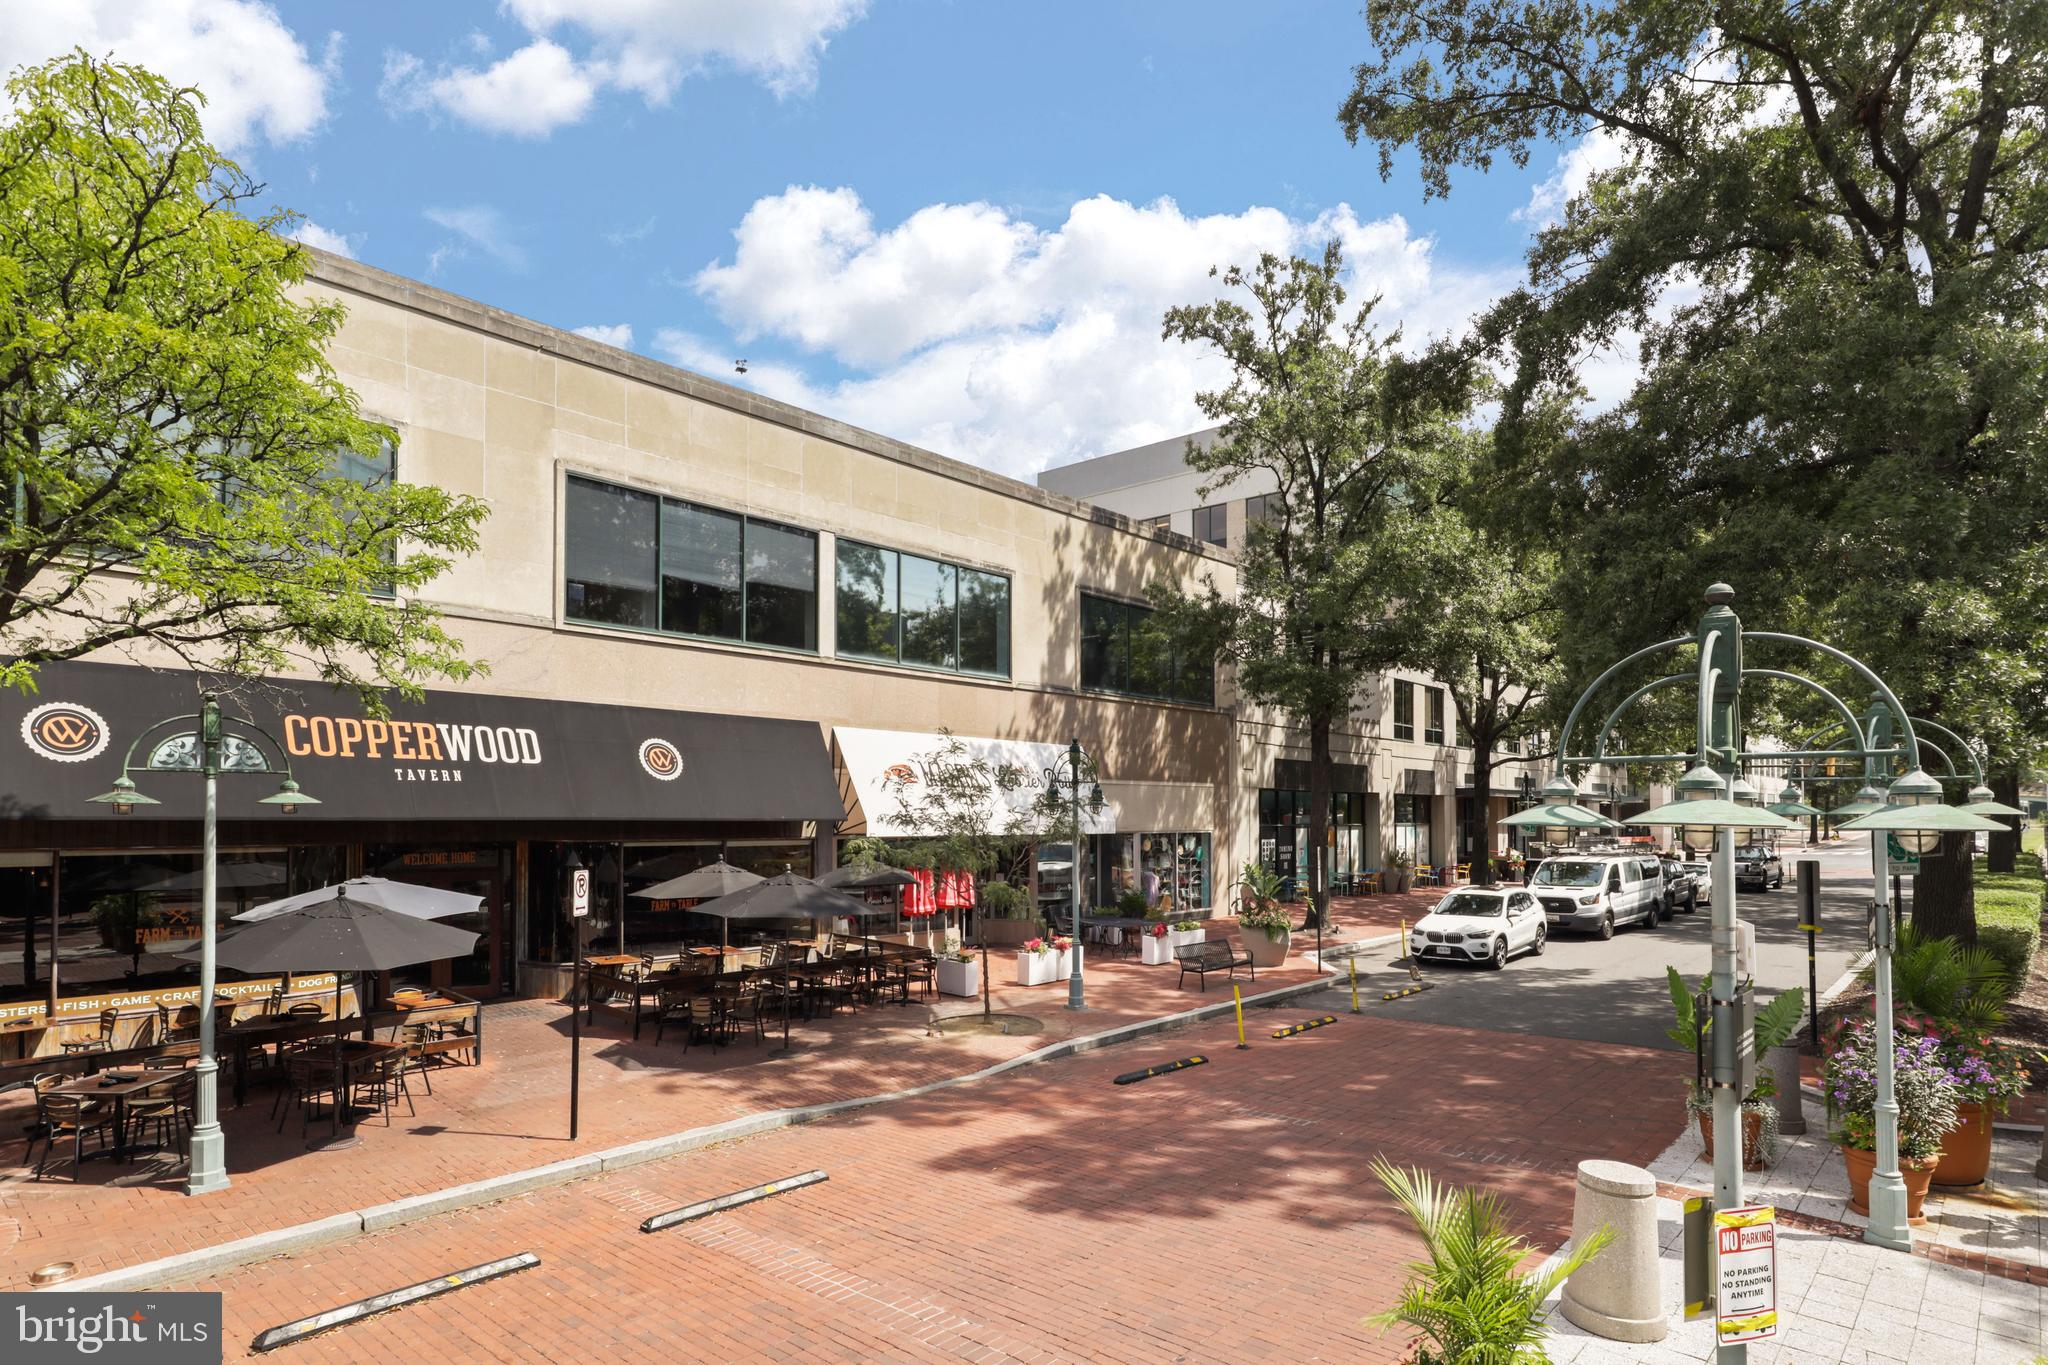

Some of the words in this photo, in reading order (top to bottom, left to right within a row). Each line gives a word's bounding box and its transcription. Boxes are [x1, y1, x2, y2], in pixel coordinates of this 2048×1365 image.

[284, 714, 542, 765] COPPERWOOD
[394, 768, 463, 783] TAVERN
[402, 852, 448, 866] WELCOME
[451, 851, 477, 865] HOME
[135, 927, 171, 945] FARM
[63, 1000, 99, 1011] FISH
[111, 994, 151, 1007] GAME
[162, 990, 202, 1002] CRAF
[298, 979, 322, 989] DOG
[1721, 1230, 1739, 1252] NO
[1741, 1230, 1772, 1246] PARKING
[1723, 1270, 1736, 1278] NO
[1737, 1264, 1769, 1277] PARKING
[1722, 1281, 1734, 1289] NO
[1735, 1275, 1772, 1288] STANDING
[1731, 1288, 1764, 1299] ANYTIME
